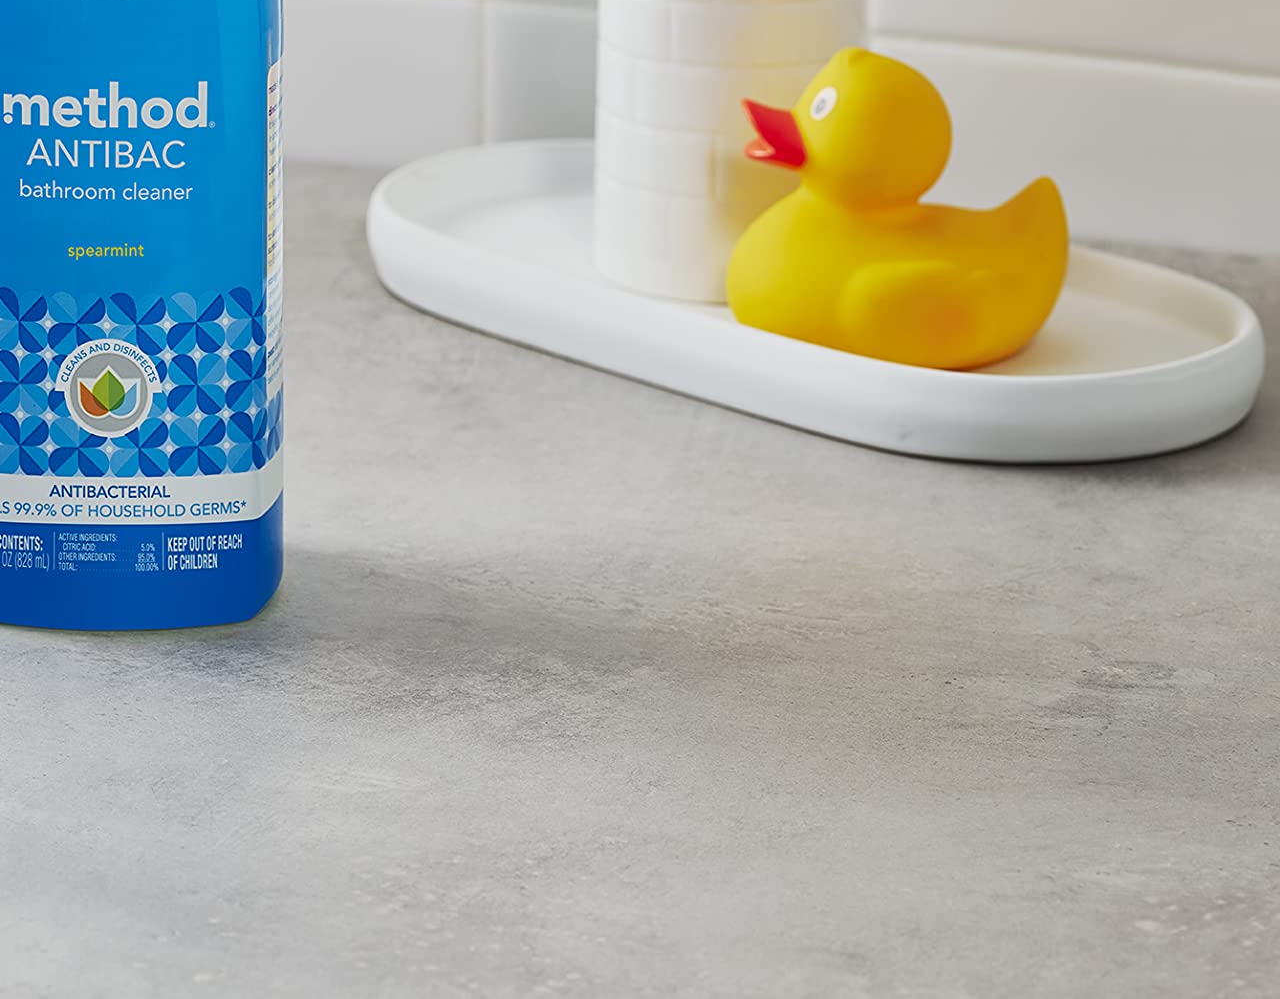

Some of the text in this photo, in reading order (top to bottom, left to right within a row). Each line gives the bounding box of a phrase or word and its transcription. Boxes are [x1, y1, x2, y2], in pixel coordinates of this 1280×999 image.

[26, 138, 187, 169] ANTIBAC
[19, 178, 193, 201] bathroom cleaner
[67, 243, 145, 261] spearmint
[60, 342, 158, 384] CLEANS AND DISINFECTS
[49, 484, 171, 499] ANTIBACTERIAL
[13, 502, 57, 517] 99.9%
[61, 504, 83, 517] OF
[87, 504, 186, 518] HOUSEHOLD
[58, 533, 78, 542] ACTIVE
[167, 533, 243, 552] KEEP OUT OF REACH
[140, 543, 156, 552] 5.0%
[1, 550, 13, 567] OZ
[14, 551, 33, 571] (828
[35, 552, 50, 572] mL)
[58, 552, 77, 561] OTHER
[136, 552, 156, 562] 95.0%
[167, 552, 218, 571] OF CHILDREN
[134, 563, 160, 572] 100.00%
